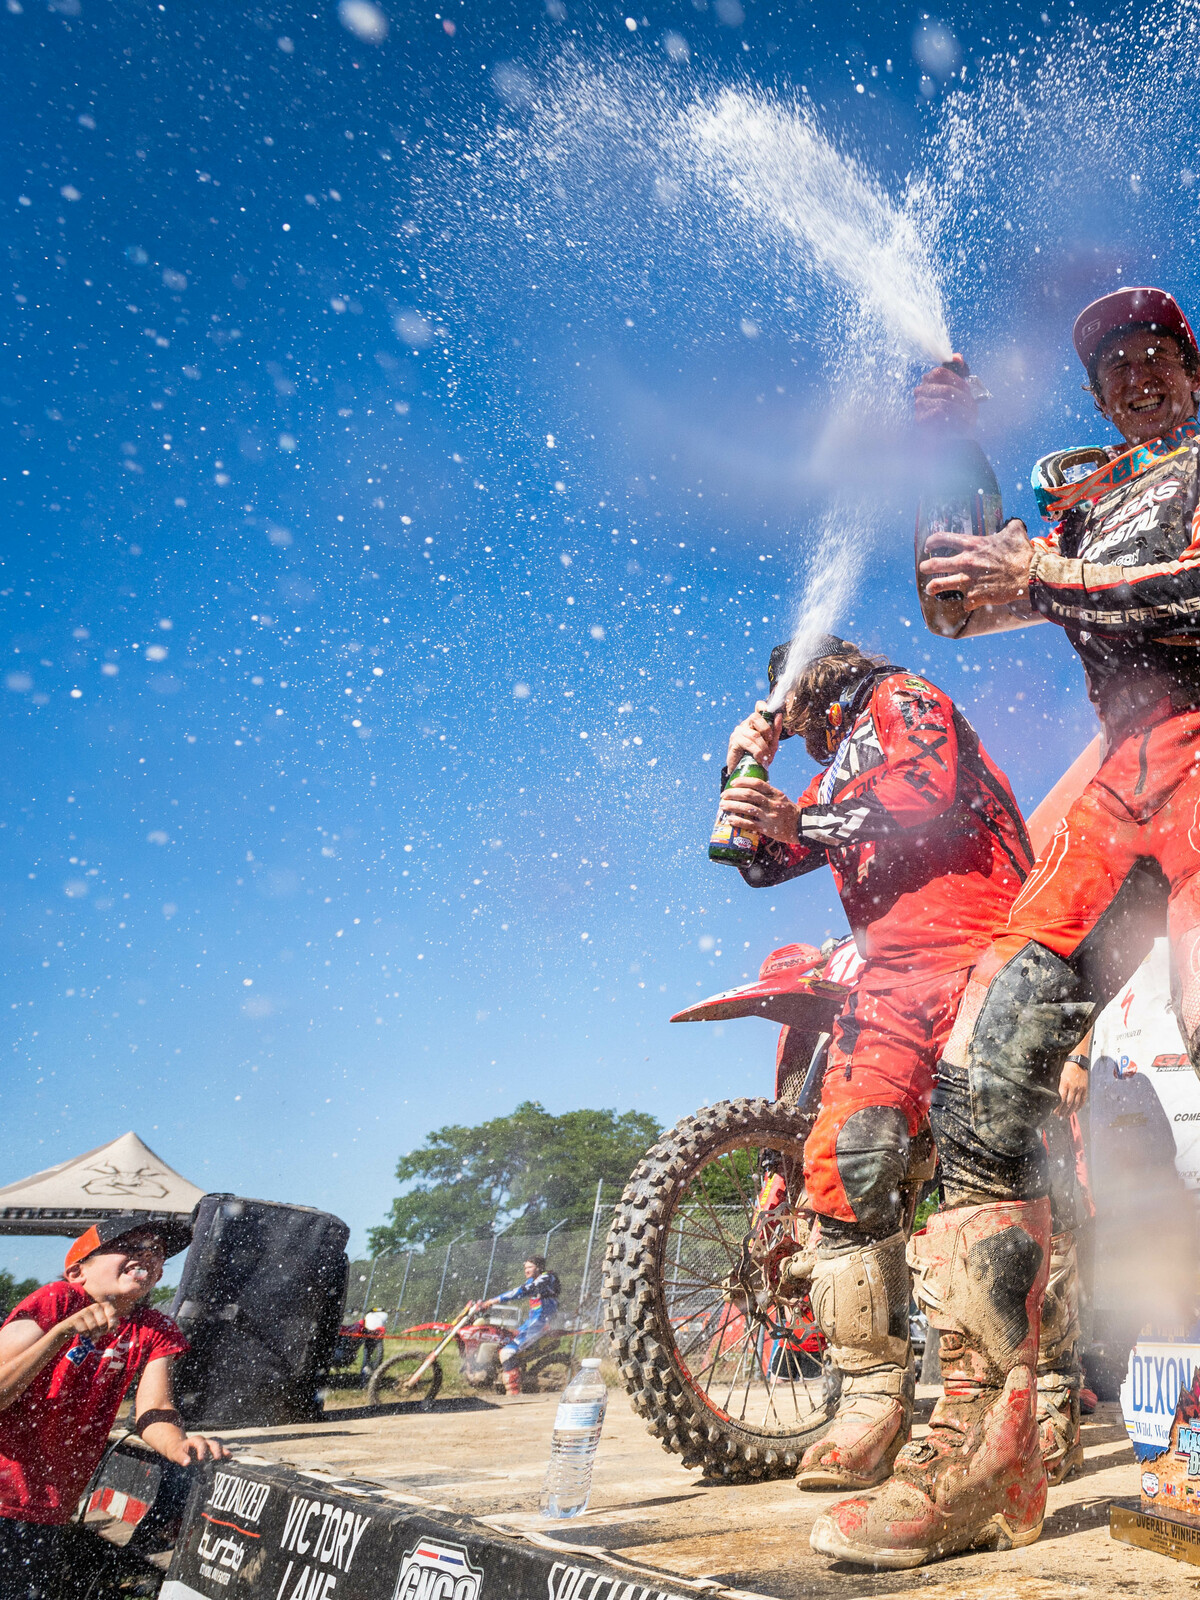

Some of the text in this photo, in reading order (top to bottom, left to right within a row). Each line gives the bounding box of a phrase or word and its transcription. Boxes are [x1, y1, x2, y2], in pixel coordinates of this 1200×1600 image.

[1051, 600, 1124, 625] MOOSE
[1135, 1420, 1153, 1437] Wild,
[280, 1496, 372, 1573] VICTORY
[1136, 1515, 1169, 1536] OVERALL
